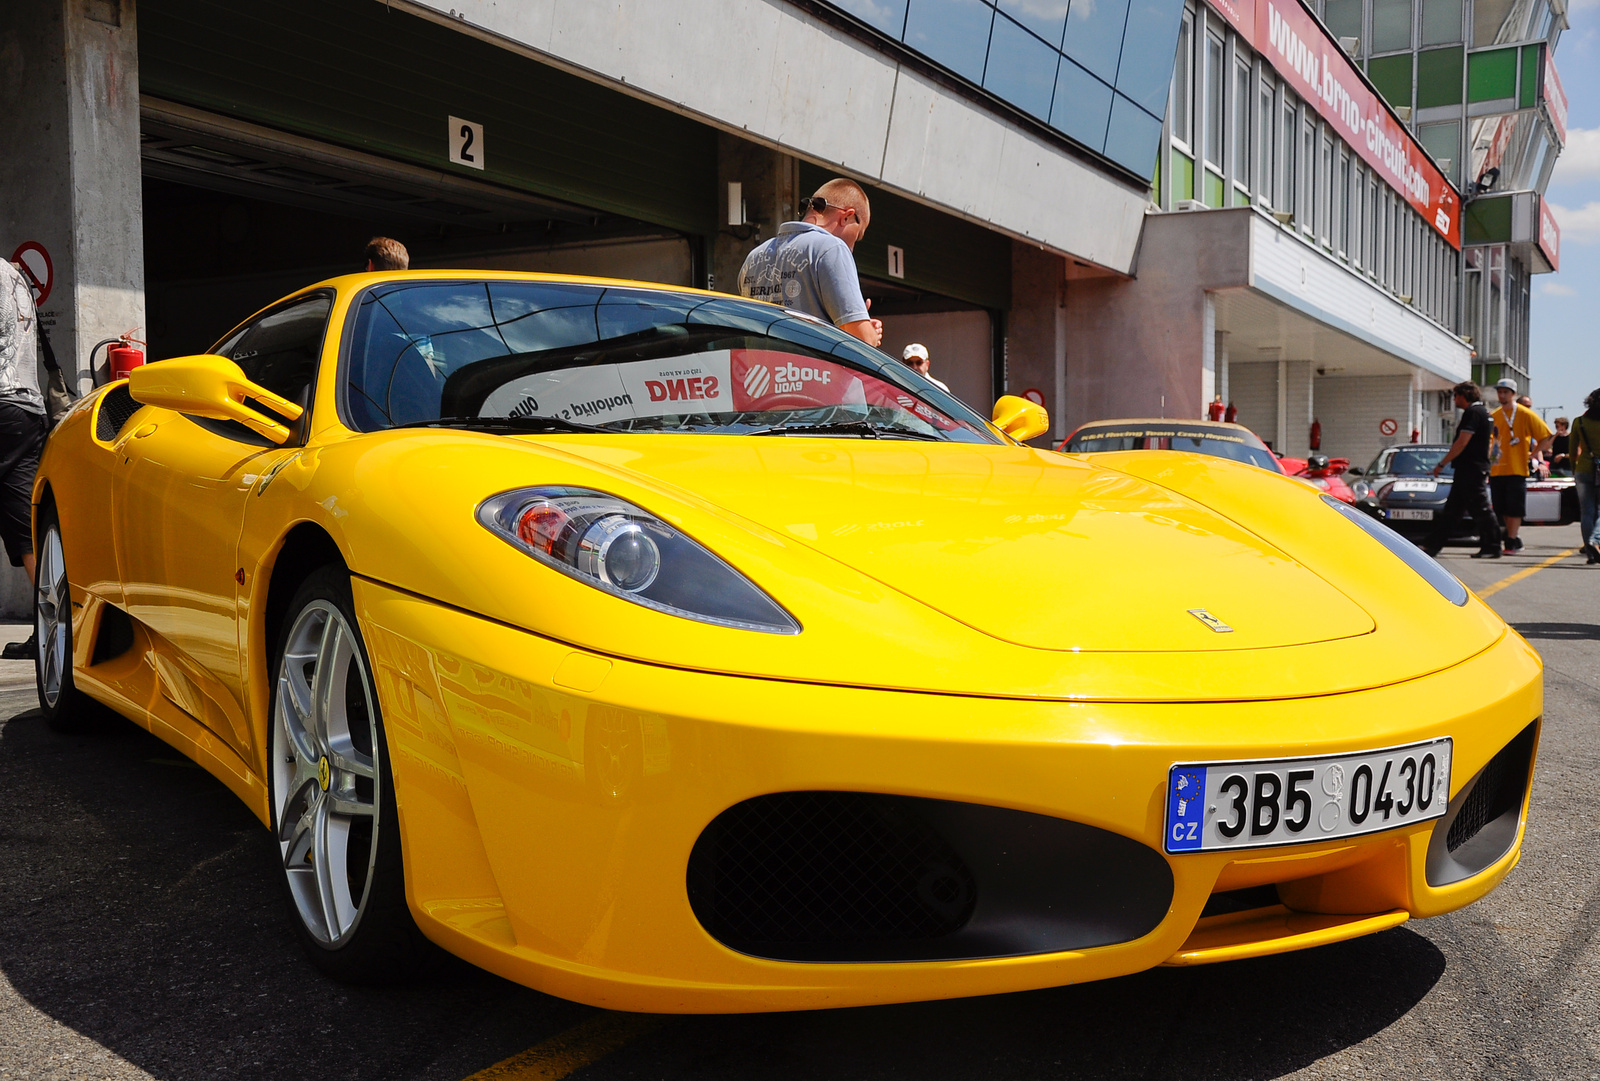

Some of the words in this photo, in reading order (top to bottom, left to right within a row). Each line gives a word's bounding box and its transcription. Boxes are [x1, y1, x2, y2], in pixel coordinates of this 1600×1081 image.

[1268, 2, 1430, 208] www.brno-circuit.com
[460, 125, 474, 162] 2
[893, 250, 899, 274] 1
[1177, 431, 1204, 439] Czech
[1205, 433, 1245, 444] Republic
[1217, 769, 1315, 838] 3B5
[1349, 751, 1436, 825] 0430
[1172, 822, 1198, 841] CZ
